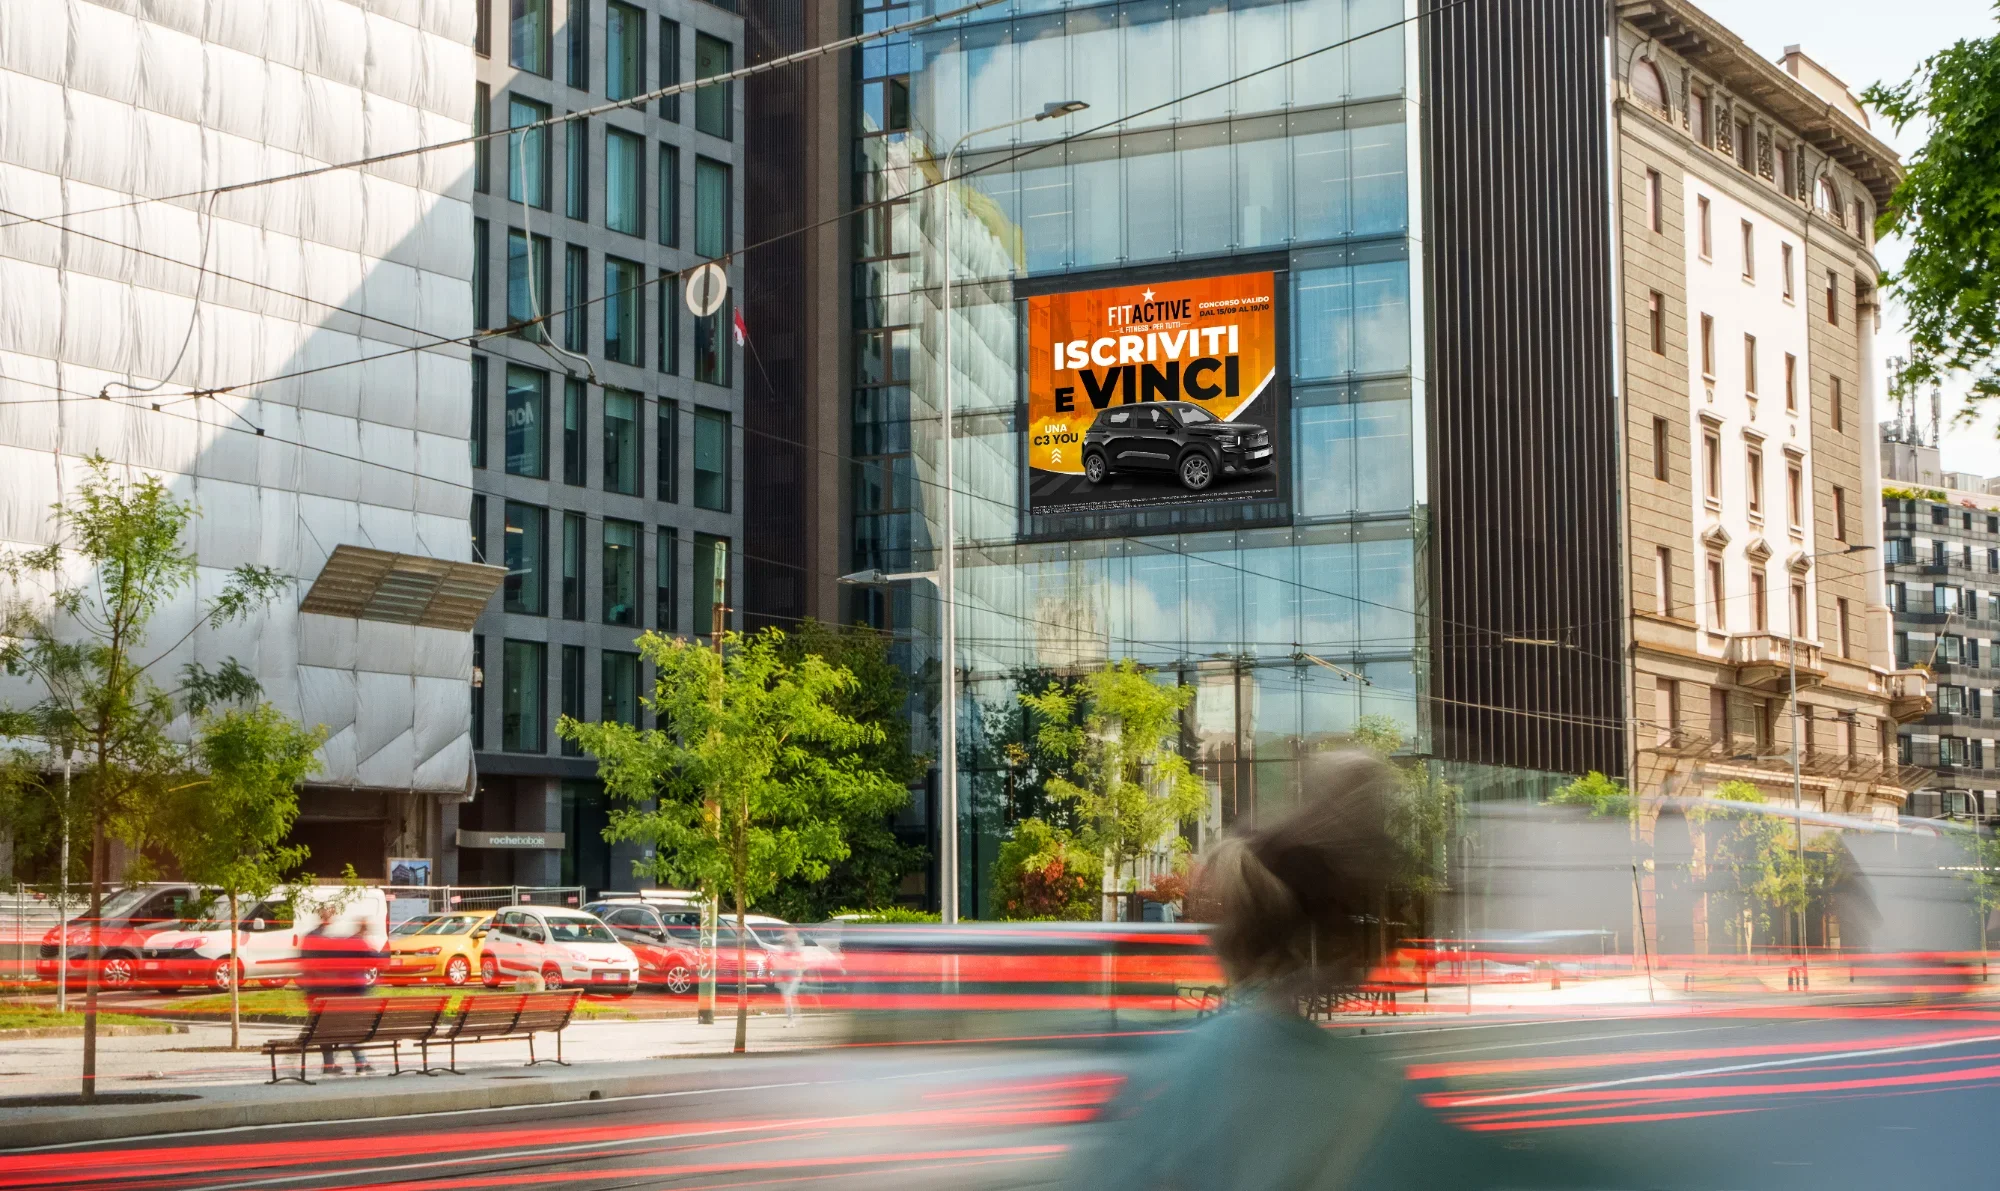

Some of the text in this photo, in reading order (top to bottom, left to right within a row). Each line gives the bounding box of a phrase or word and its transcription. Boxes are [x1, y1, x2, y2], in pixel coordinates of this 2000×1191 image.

[1198, 296, 1269, 308] CONCORSO VALIDO
[1108, 299, 1191, 326] FITACTIVE
[1216, 307, 1237, 315] 15/09
[1250, 303, 1269, 312] 19/10
[1125, 324, 1149, 333] FITNESS
[1165, 321, 1180, 329] TUTTI
[1054, 324, 1239, 370] ISCRIVITI
[1055, 355, 1240, 412] E VINCI
[1044, 423, 1067, 434] UNA
[1034, 432, 1079, 446] C3 YOU
